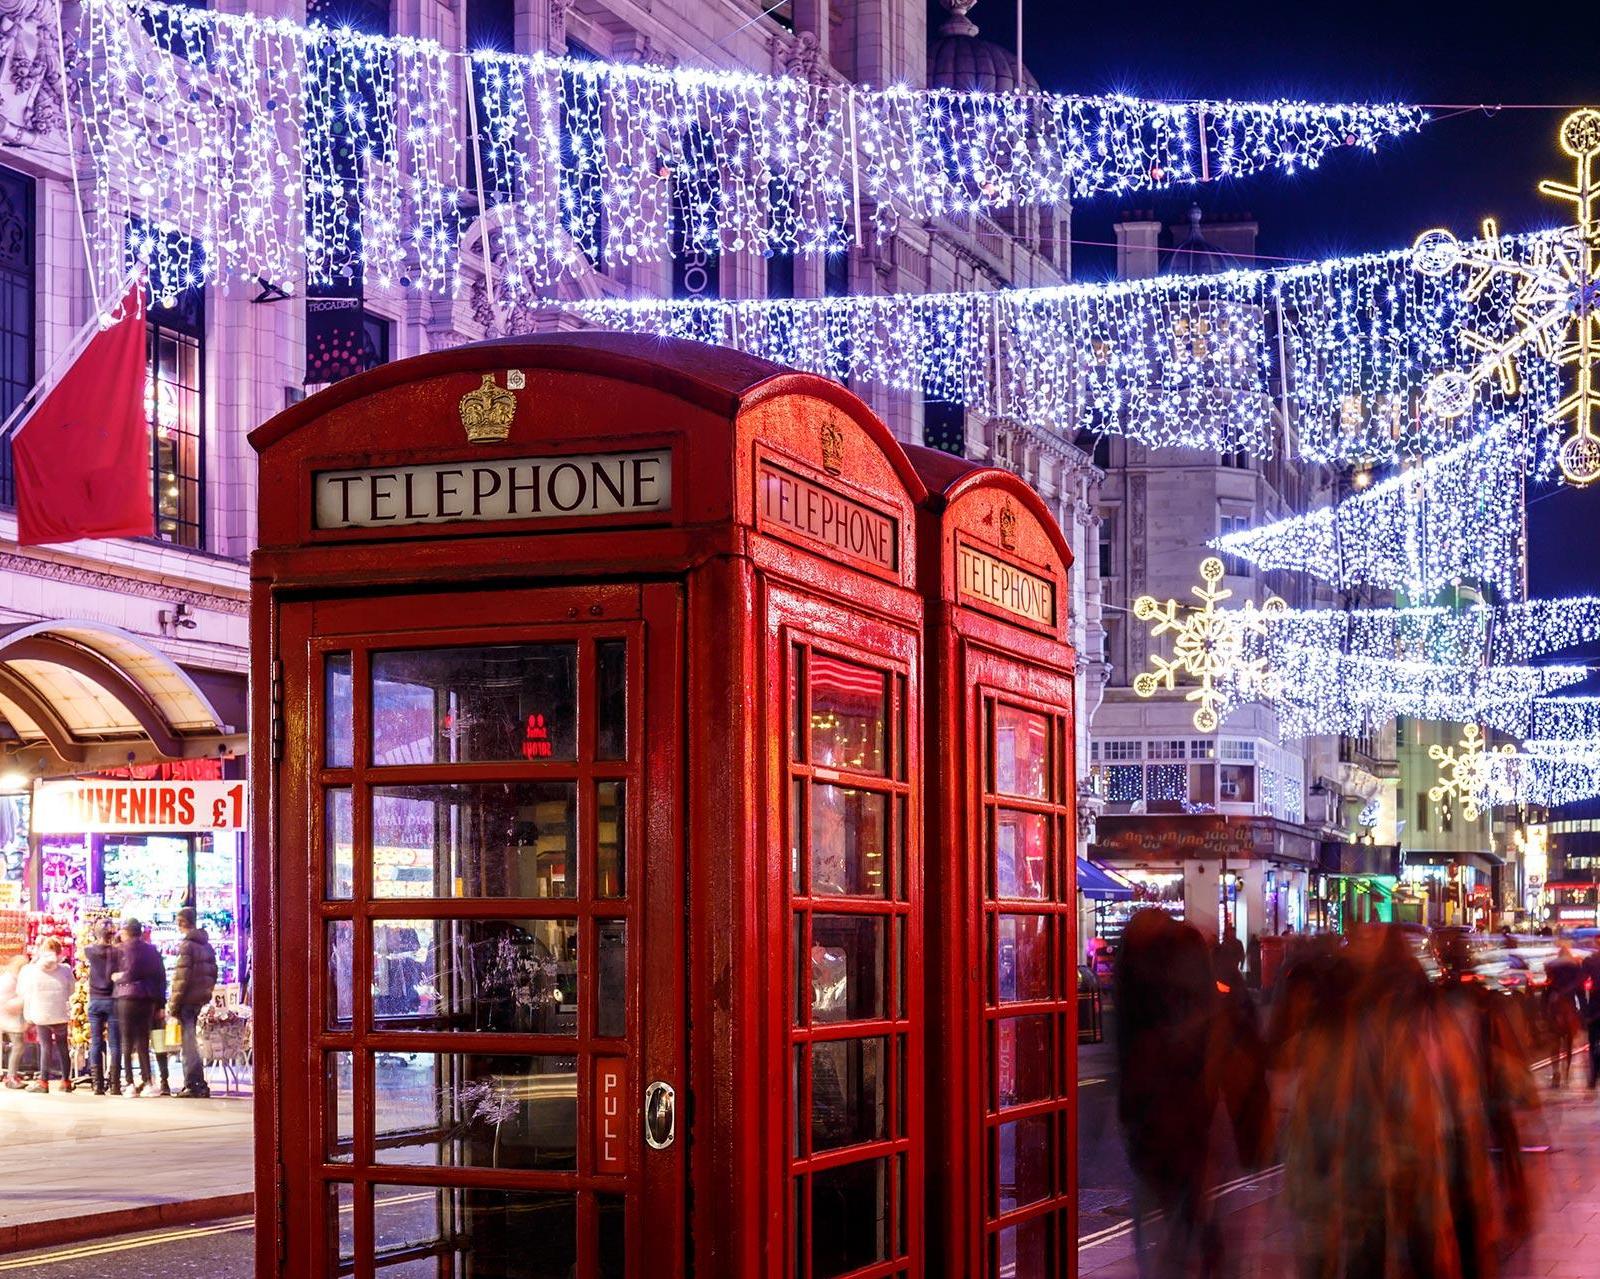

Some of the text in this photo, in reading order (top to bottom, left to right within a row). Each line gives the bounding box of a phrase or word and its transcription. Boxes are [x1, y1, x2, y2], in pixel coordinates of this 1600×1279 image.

[327, 457, 662, 523] TELEPHONE
[761, 470, 890, 564] TELEPHONE
[960, 550, 1051, 621] TELEPHONE
[65, 783, 244, 828] UVENIRS £1
[215, 994, 226, 1008] £1
[604, 1073, 617, 1161] PULL
